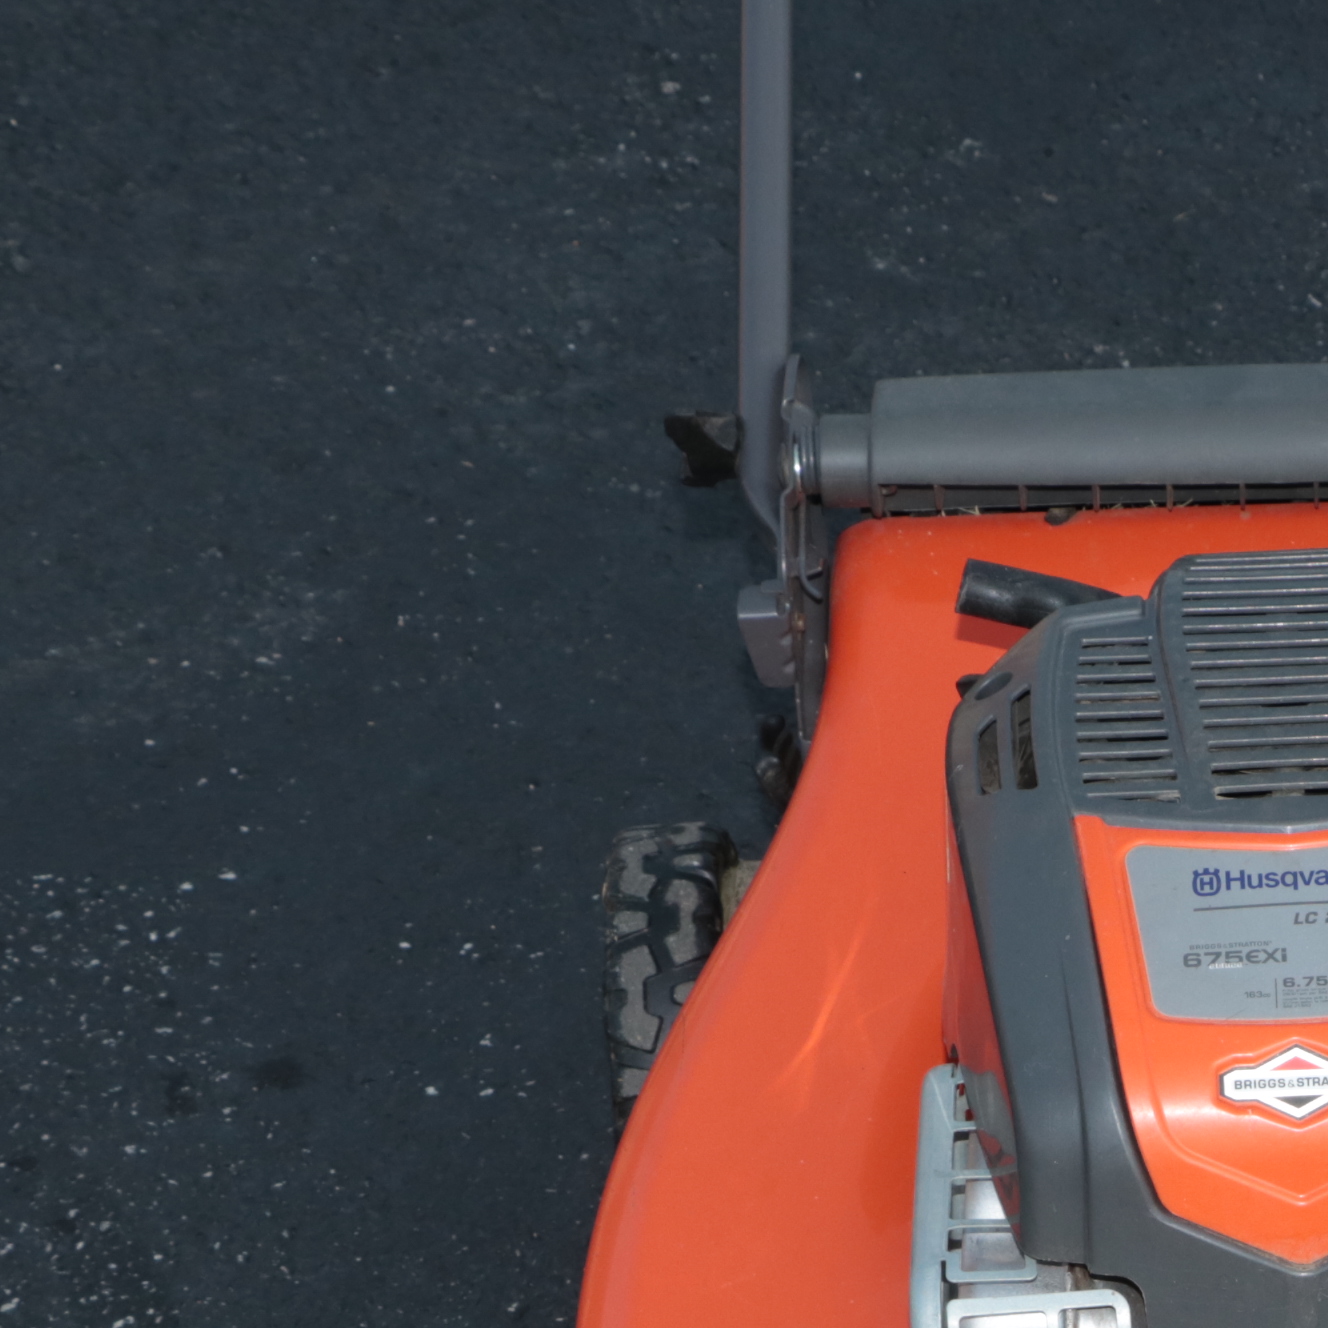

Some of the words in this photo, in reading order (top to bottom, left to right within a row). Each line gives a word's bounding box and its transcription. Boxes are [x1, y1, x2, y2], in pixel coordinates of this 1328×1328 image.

[1293, 912, 1319, 925] LC
[1182, 947, 1288, 968] 675EXi
[1282, 976, 1328, 988] 6.75
